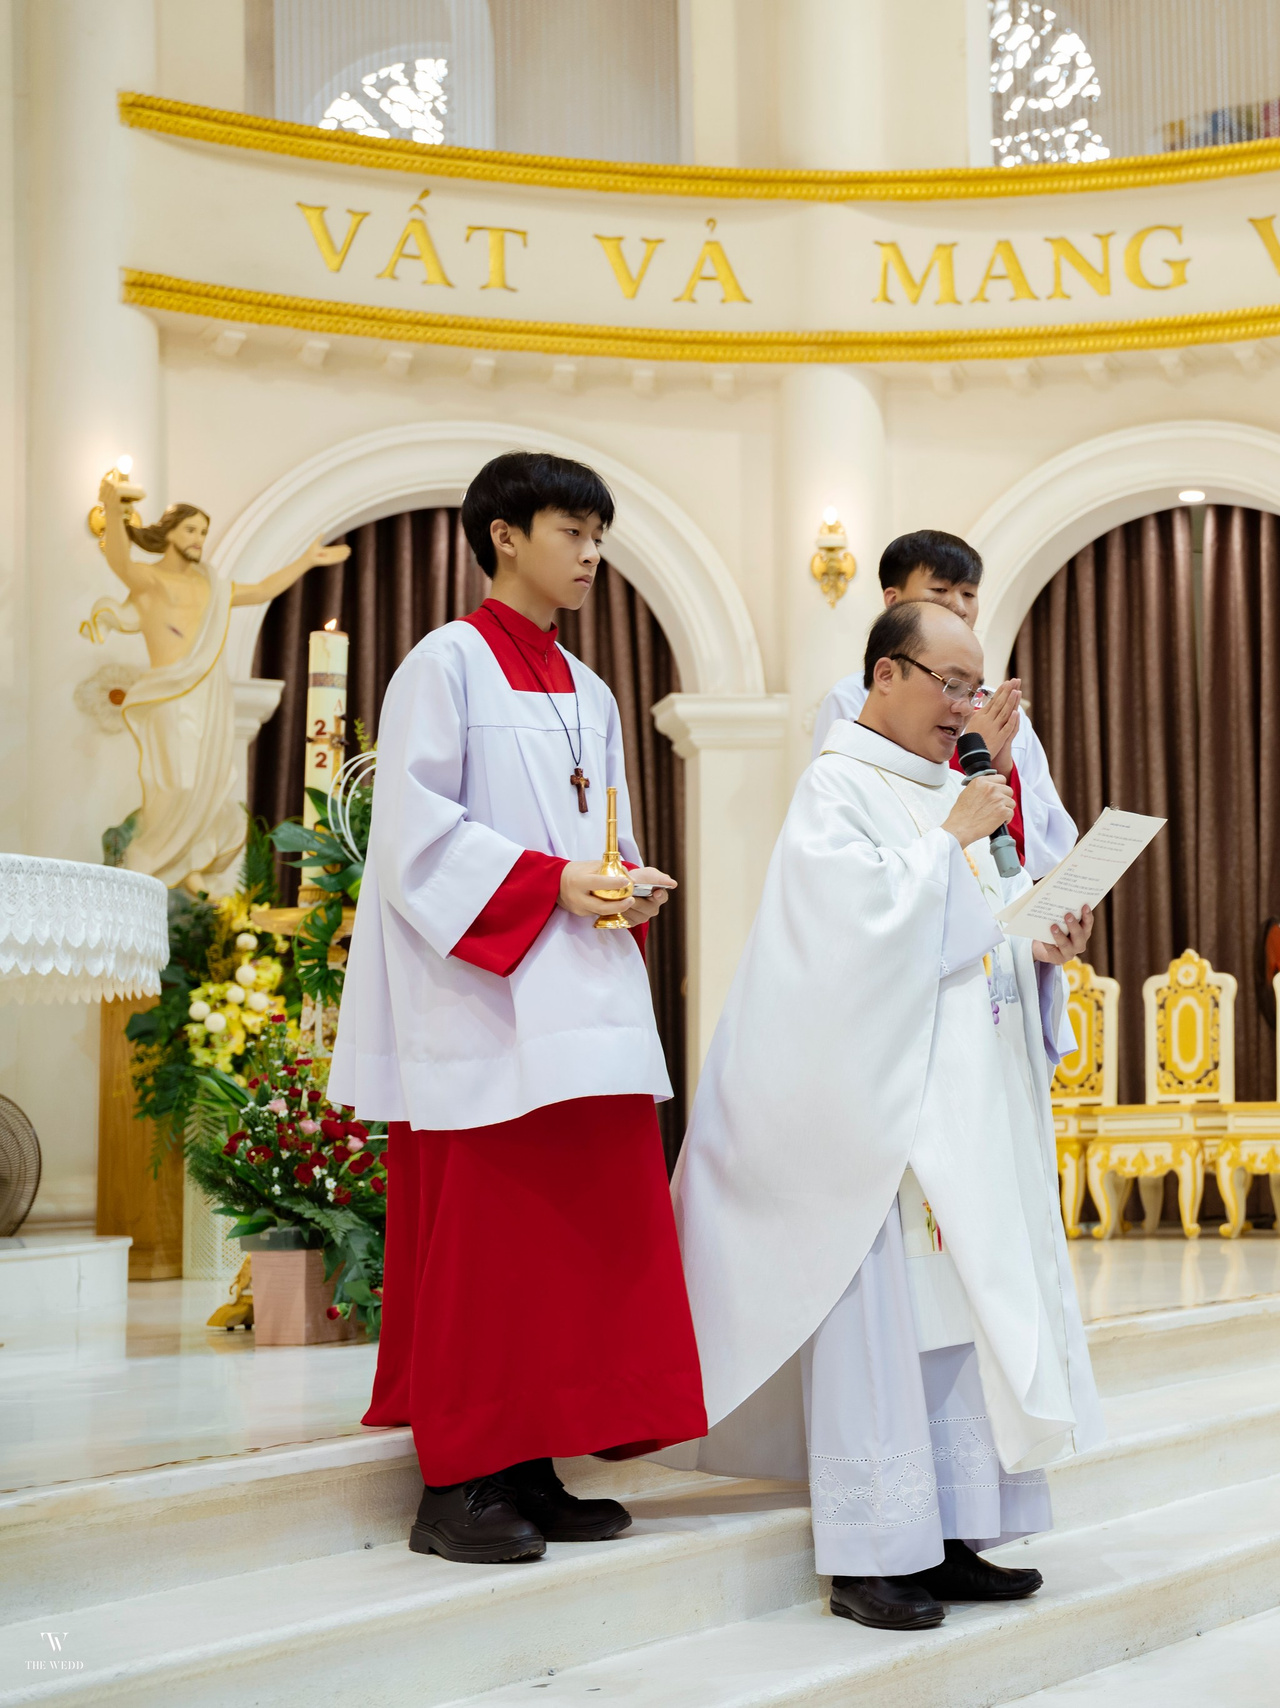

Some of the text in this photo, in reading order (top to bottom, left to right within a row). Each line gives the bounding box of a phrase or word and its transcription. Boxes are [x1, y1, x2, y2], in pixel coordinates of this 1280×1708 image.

[296, 188, 528, 293] VẤT
[593, 217, 752, 303] VẢ
[872, 224, 1192, 306] MANG
[315, 720, 327, 736] 2
[315, 752, 327, 768] 2
